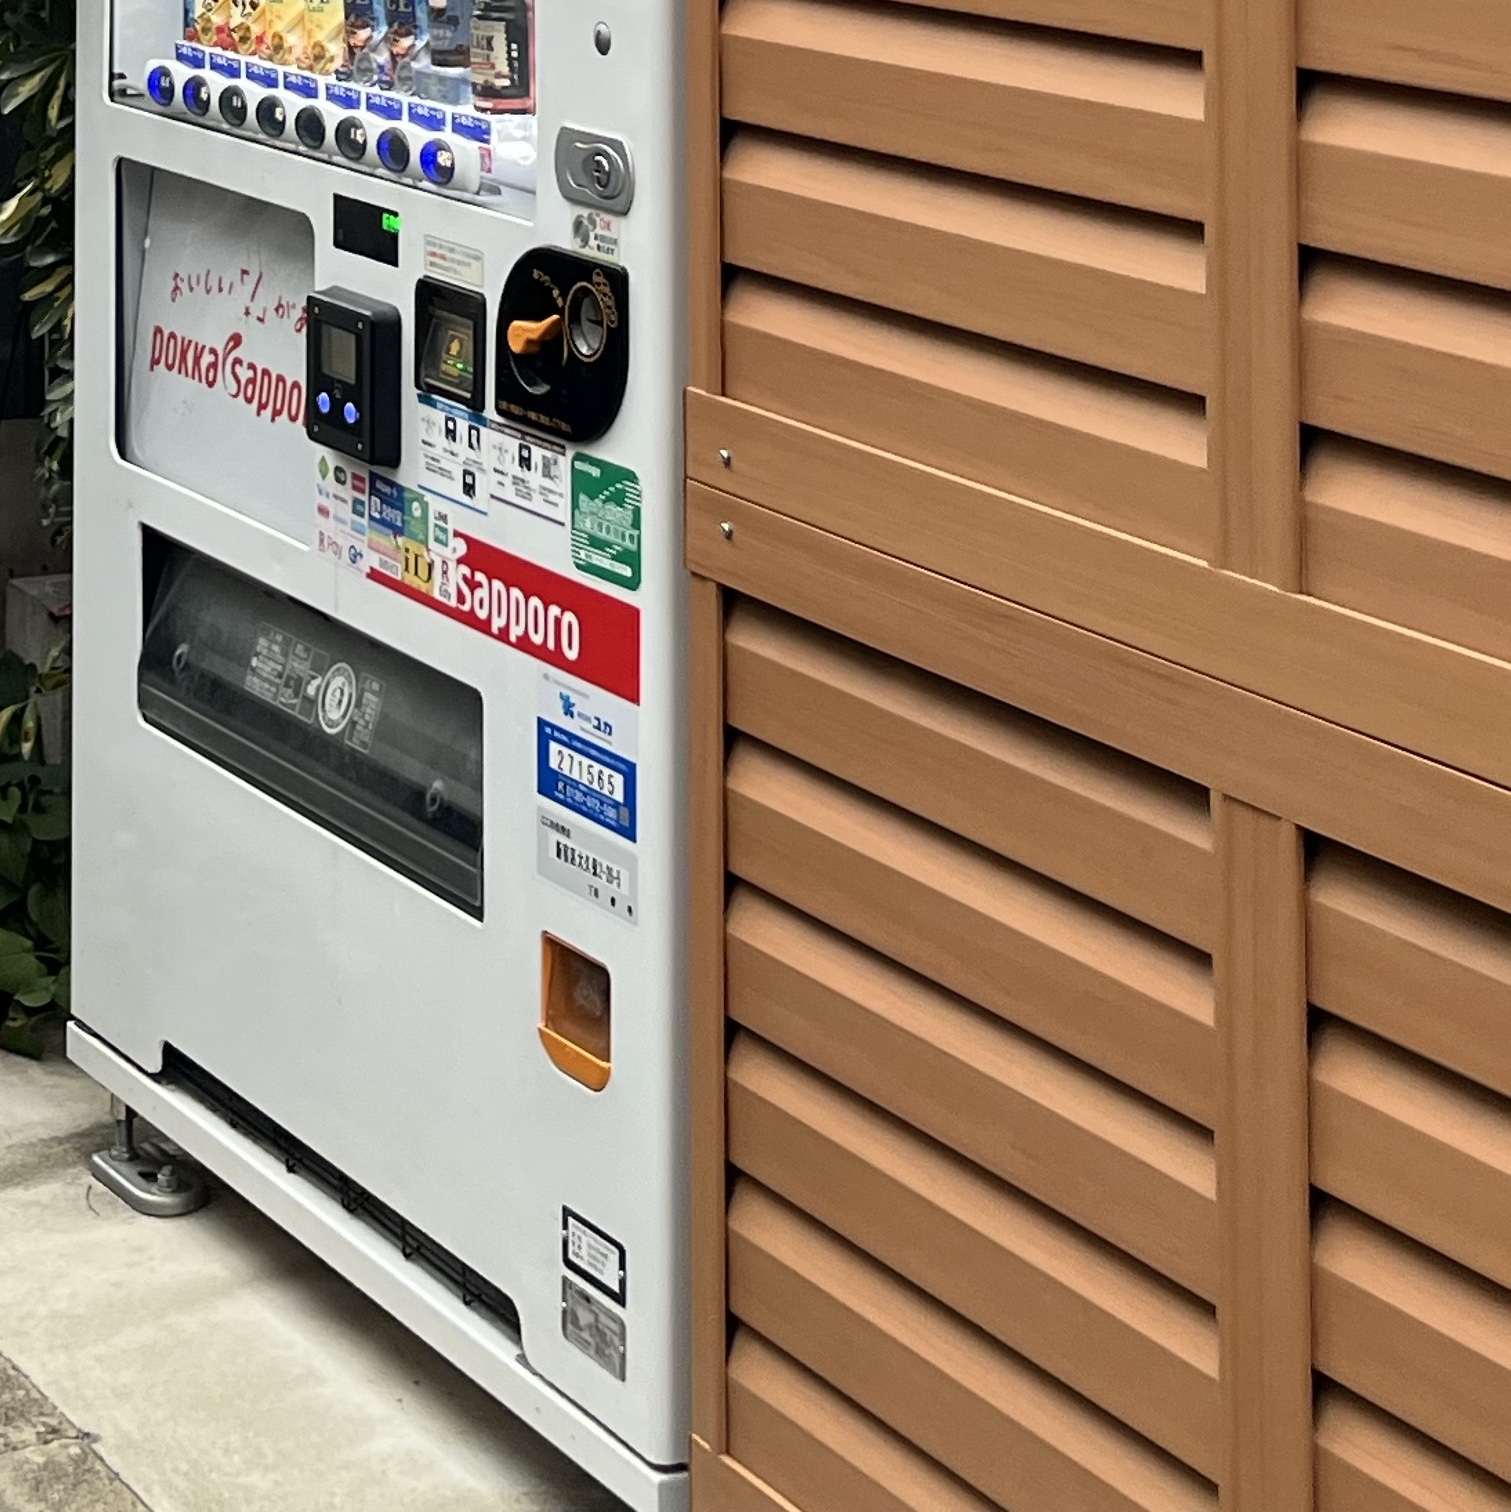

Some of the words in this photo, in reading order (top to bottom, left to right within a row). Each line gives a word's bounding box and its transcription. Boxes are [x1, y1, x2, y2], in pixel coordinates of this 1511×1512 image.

[228, 355, 308, 429] sappo
[404, 547, 432, 584] iD
[456, 563, 581, 662] sapporo
[557, 749, 616, 796] 271565
